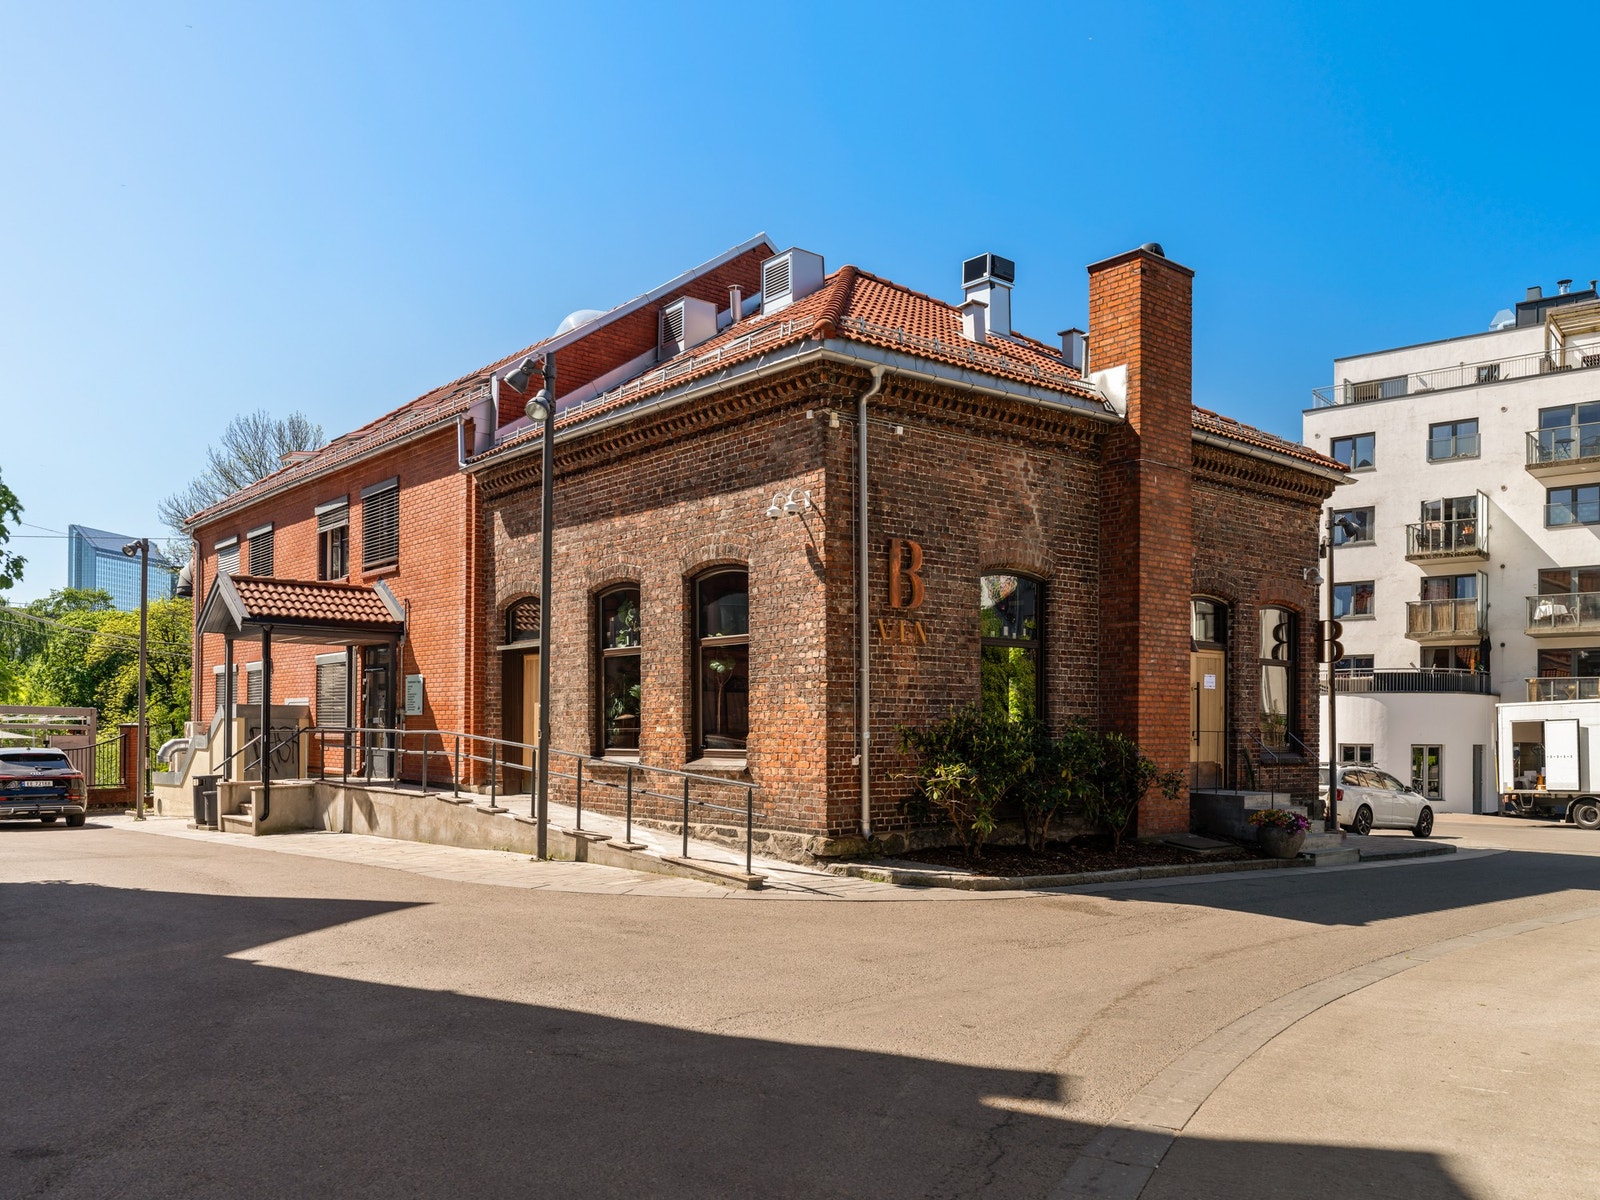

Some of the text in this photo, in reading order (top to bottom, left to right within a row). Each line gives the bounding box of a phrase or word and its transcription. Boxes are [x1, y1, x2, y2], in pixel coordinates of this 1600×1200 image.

[889, 538, 924, 609] B
[877, 618, 927, 645] VIN
[1315, 620, 1344, 663] B
